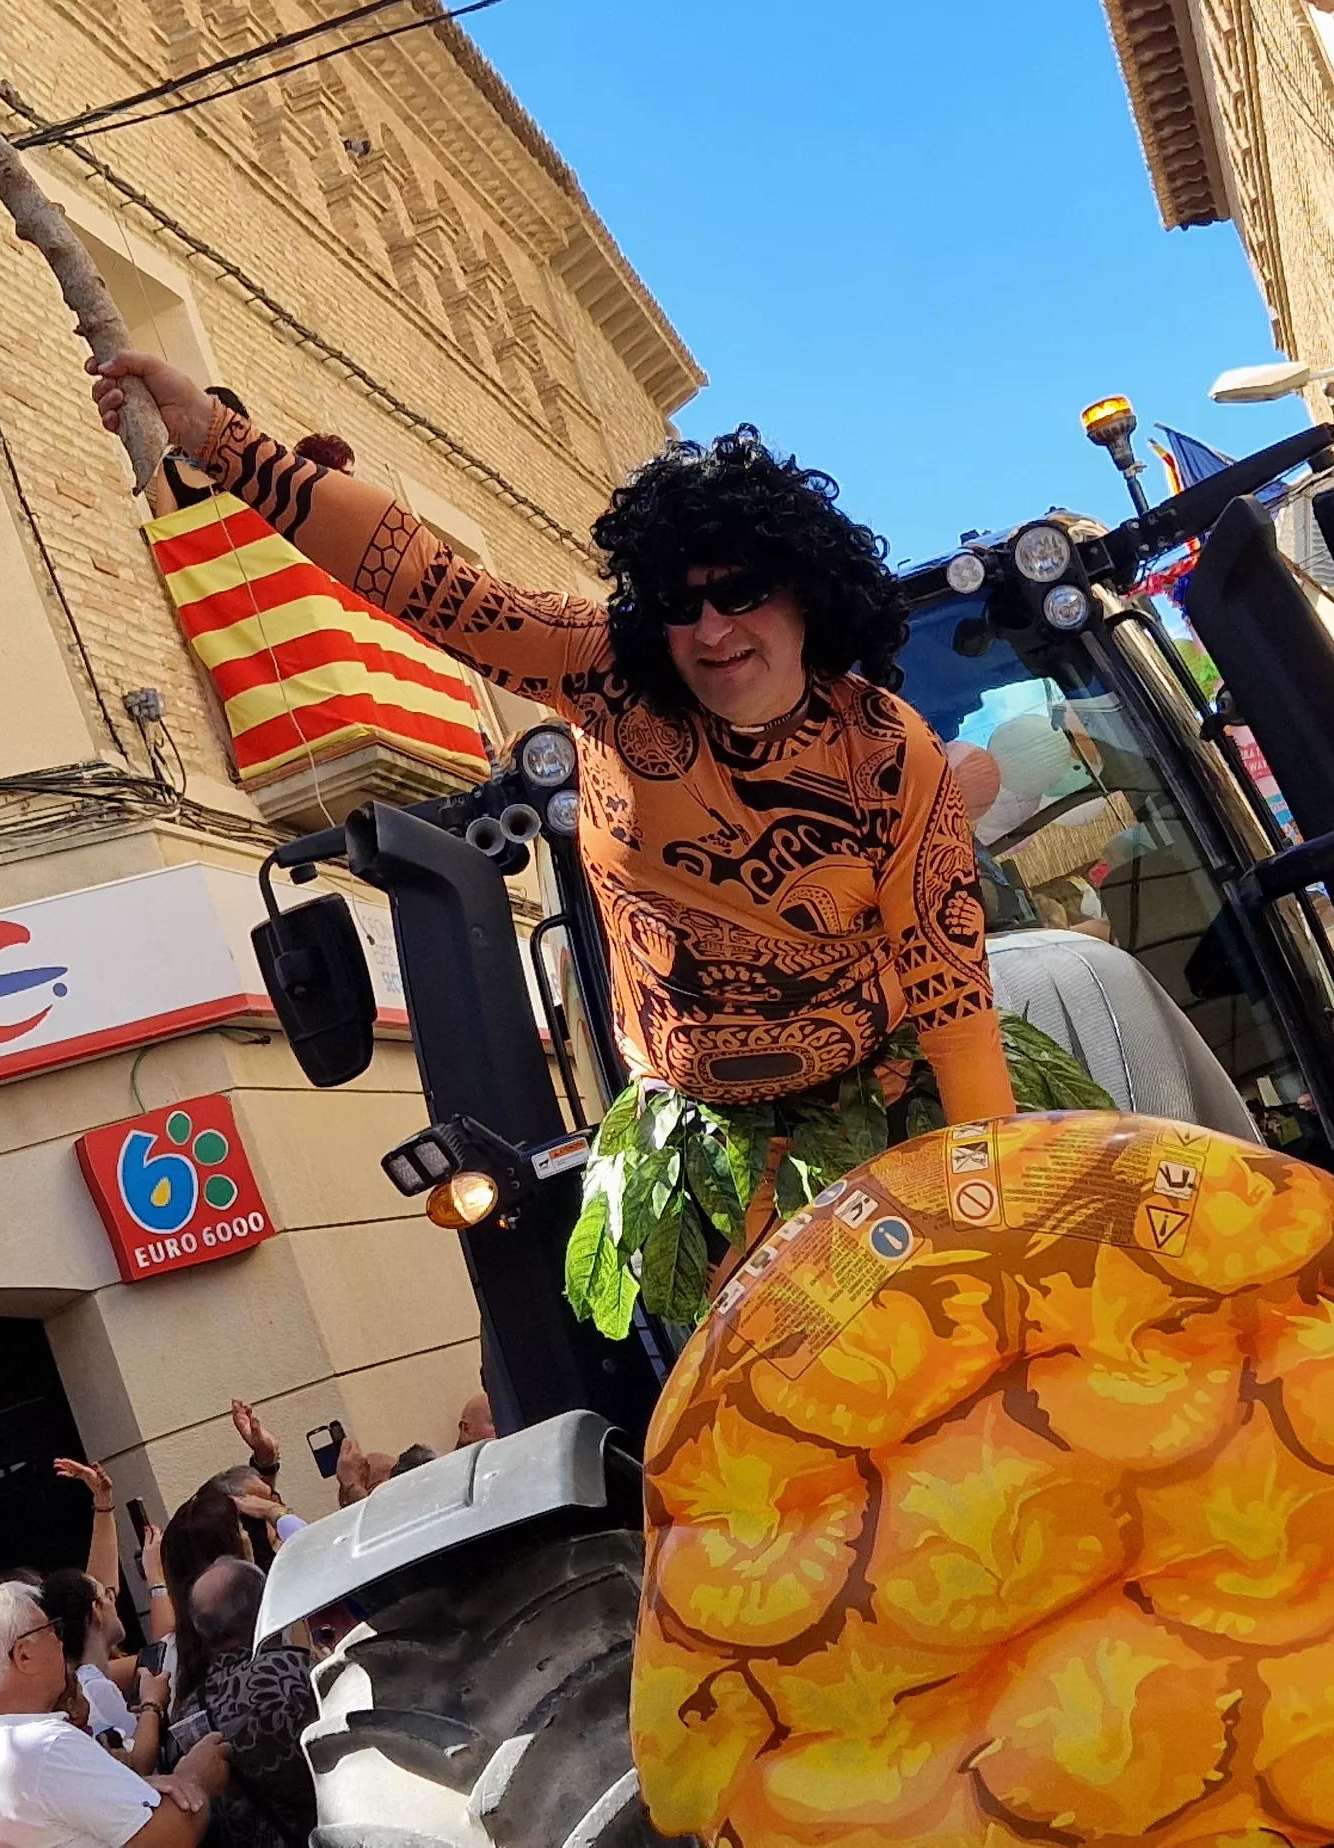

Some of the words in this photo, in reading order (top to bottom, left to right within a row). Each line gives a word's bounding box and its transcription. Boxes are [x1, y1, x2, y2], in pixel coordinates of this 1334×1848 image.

[117, 1129, 199, 1235] 6
[134, 1232, 198, 1268] EURO
[202, 1211, 265, 1247] 6000
